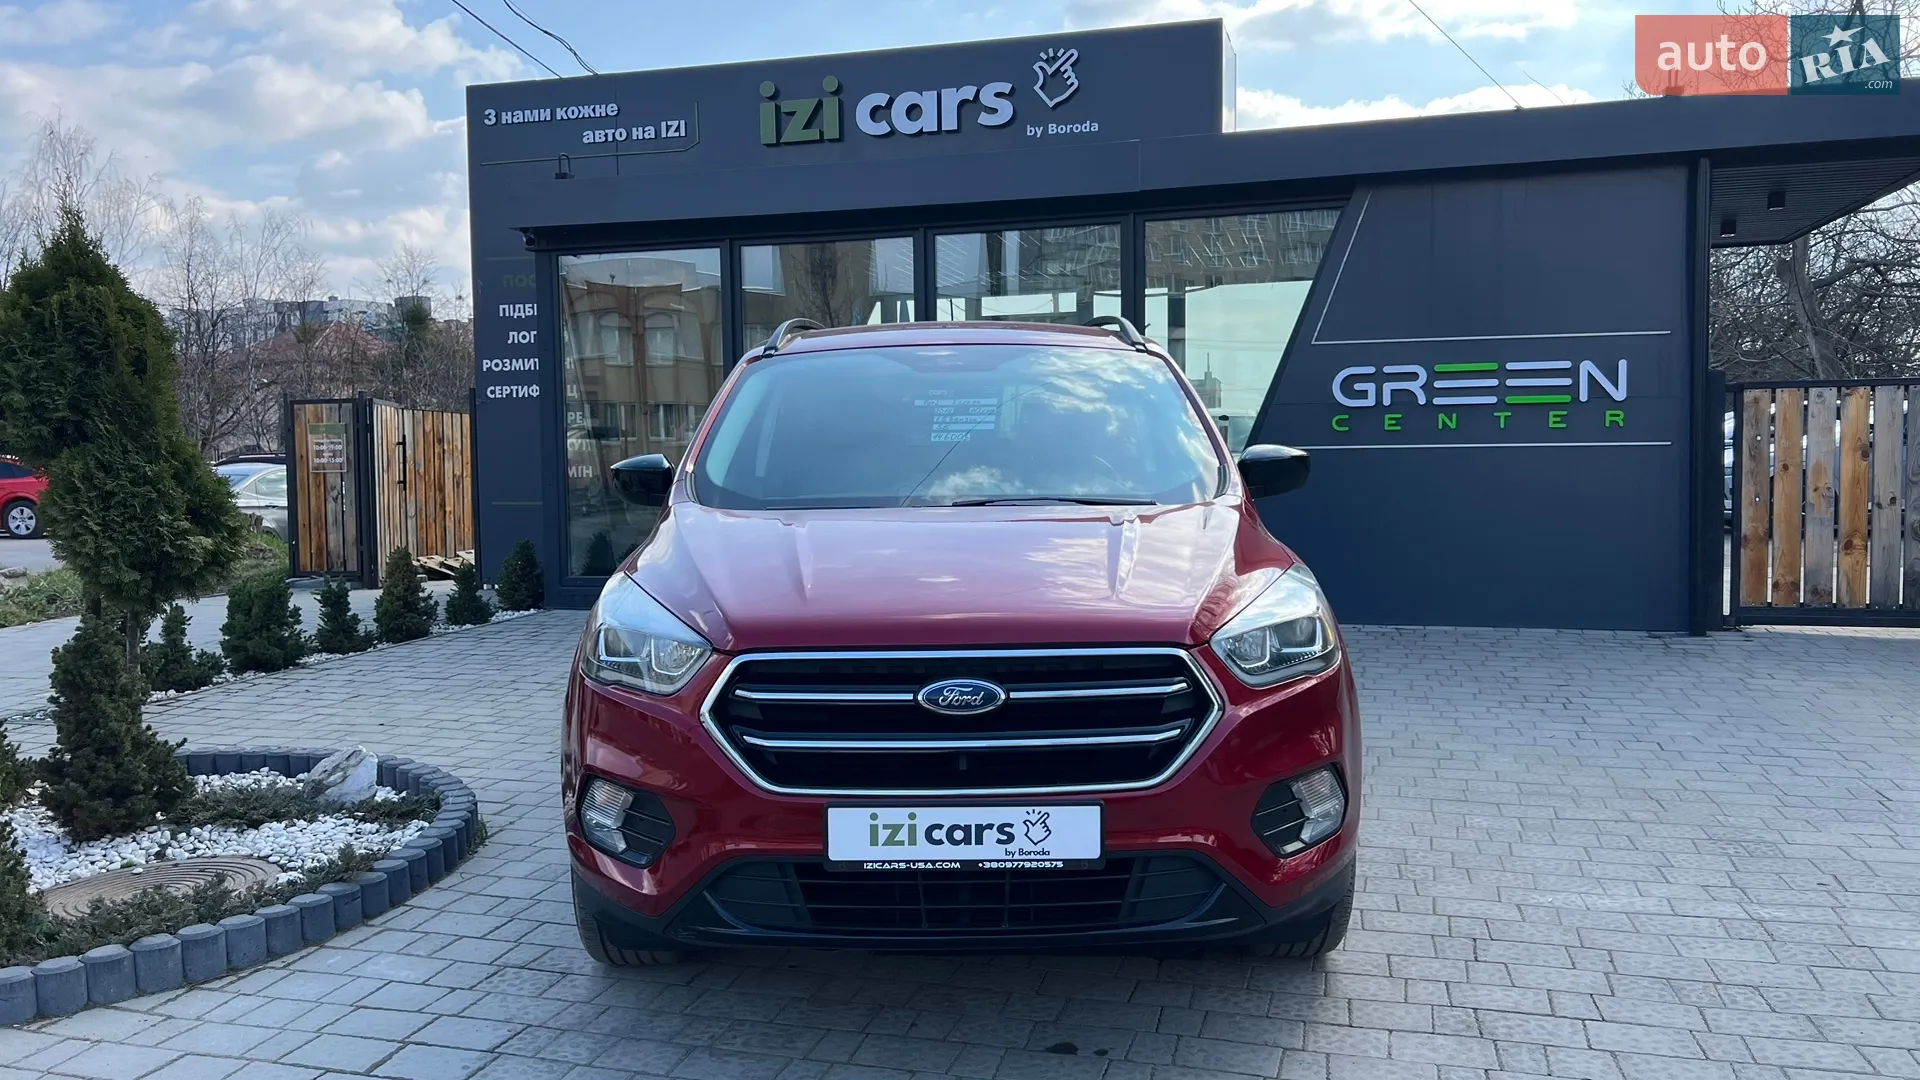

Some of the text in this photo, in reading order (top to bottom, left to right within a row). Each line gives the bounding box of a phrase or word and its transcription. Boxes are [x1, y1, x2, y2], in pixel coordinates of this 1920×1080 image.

[501, 107, 552, 125] нами
[556, 103, 619, 121] кожне
[759, 76, 1016, 146] izi cars
[582, 120, 686, 144] авто на IZI
[1026, 120, 1099, 138] by Boroda
[486, 384, 540, 398] СЕРТИФ
[1331, 358, 1628, 408] GREEN
[1331, 409, 1625, 432] CENTER
[938, 686, 985, 706] Ford
[869, 812, 1016, 847] izi cars
[1004, 848, 1050, 858] by Boroda
[863, 861, 1064, 870] IZICARS-USA.COM +380977920575
